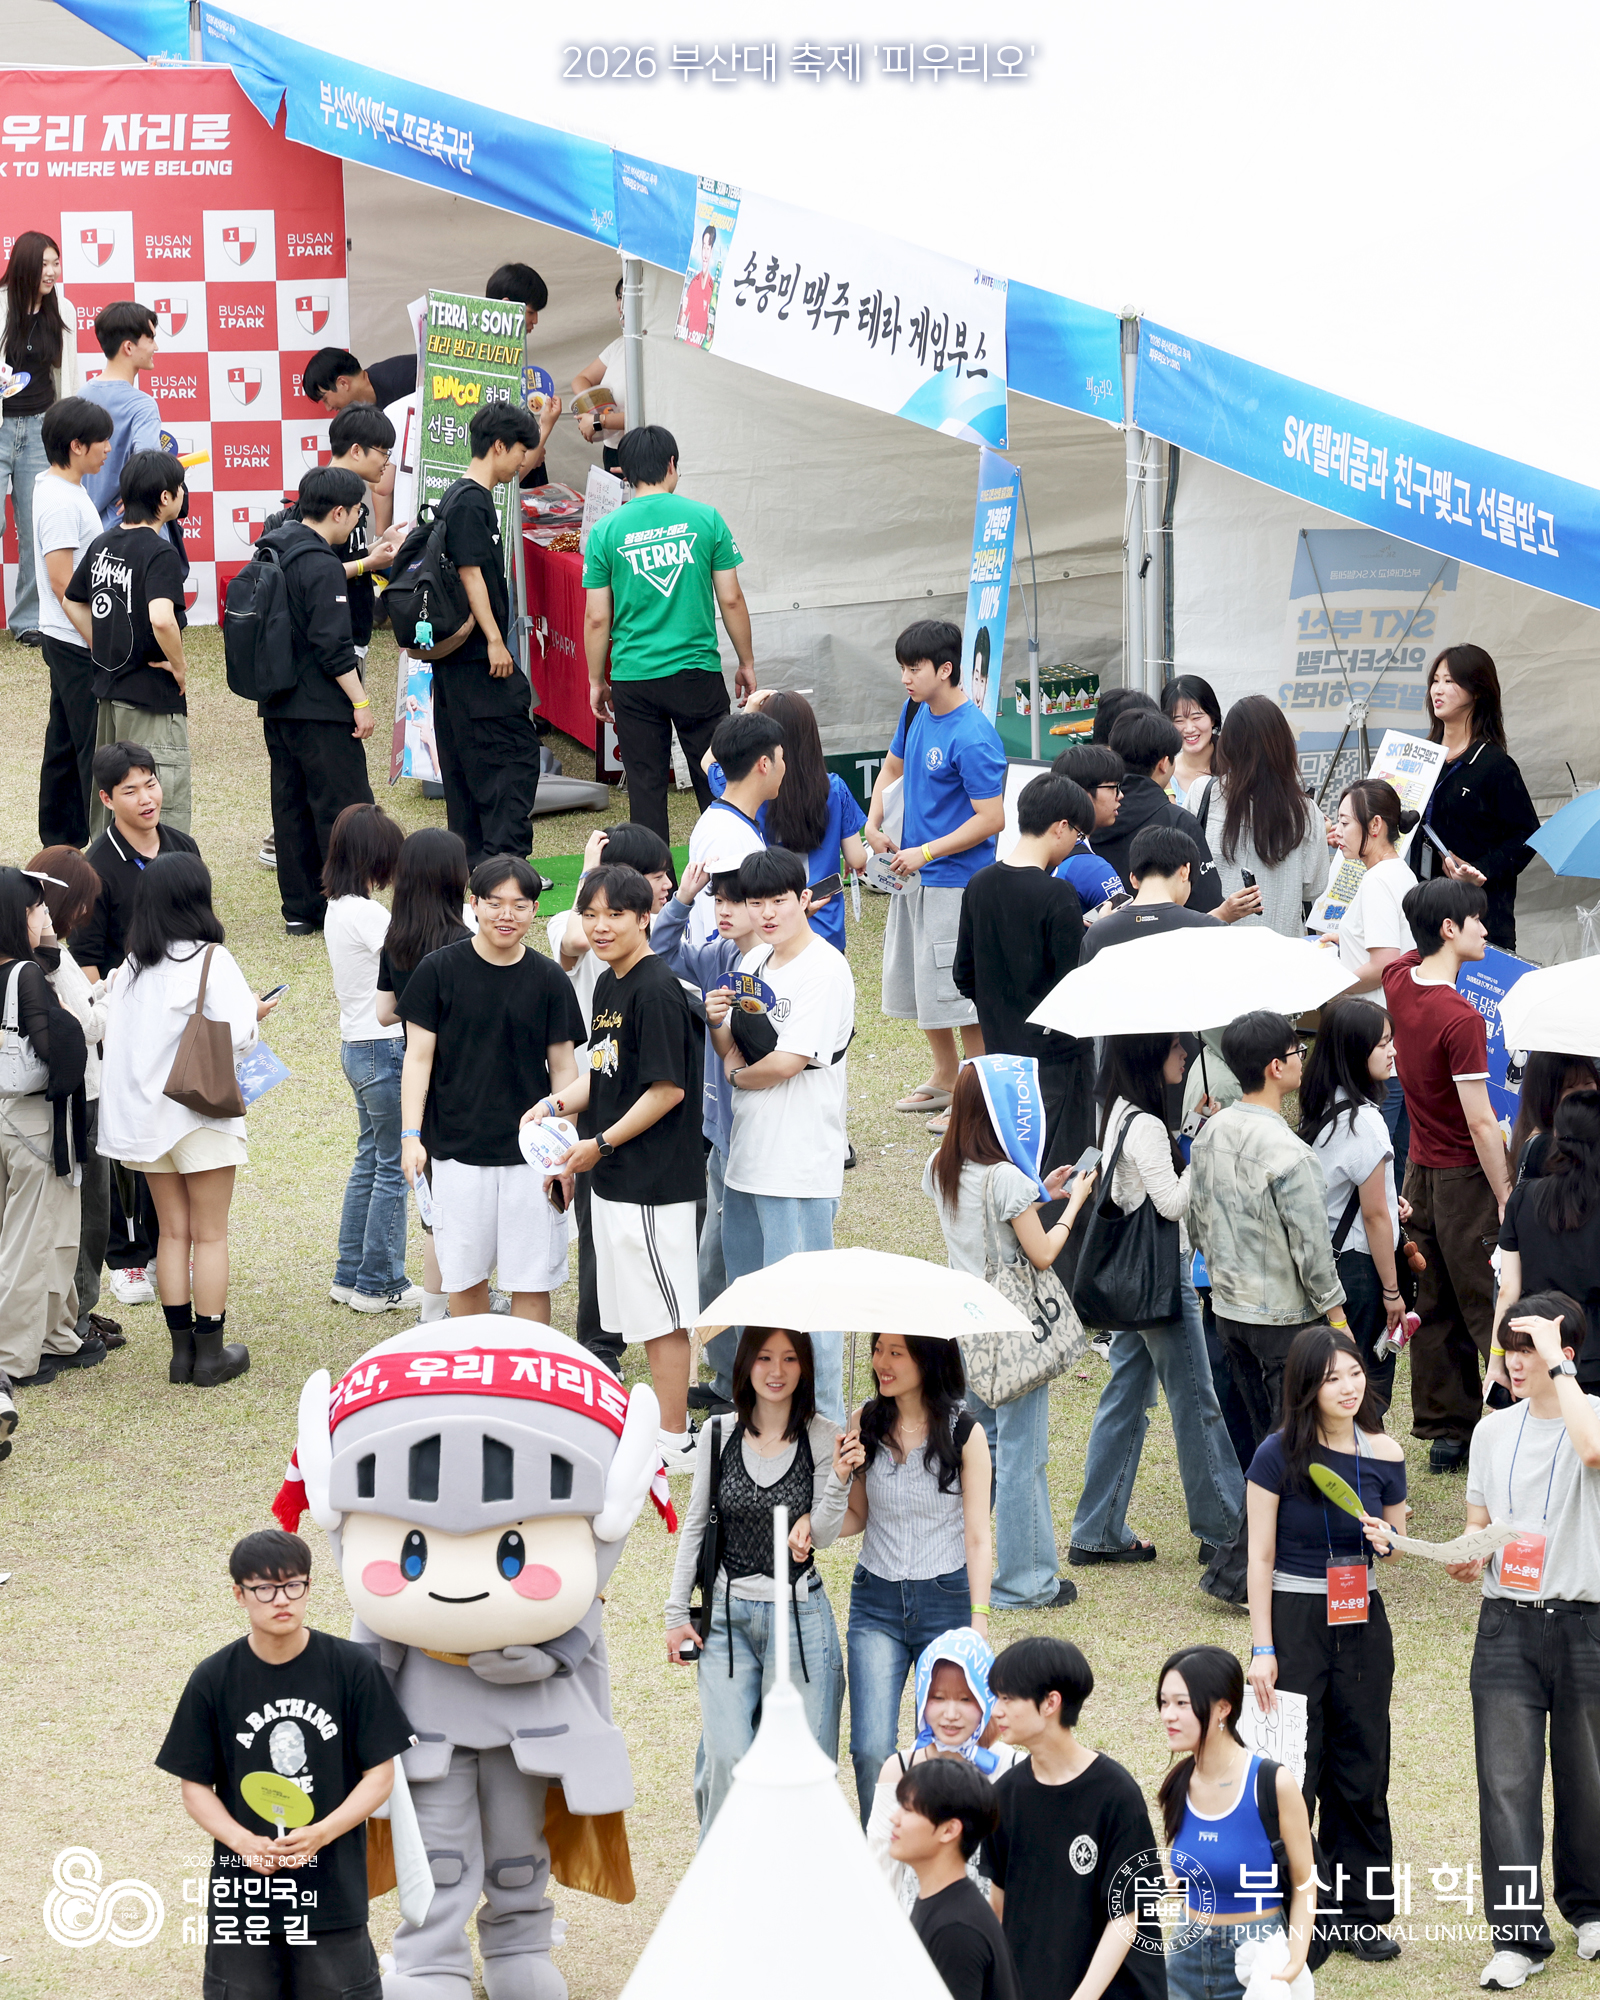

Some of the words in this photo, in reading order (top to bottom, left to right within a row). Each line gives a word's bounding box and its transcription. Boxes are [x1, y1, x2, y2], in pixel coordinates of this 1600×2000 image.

[319, 80, 397, 145] 부산아이파크
[2, 114, 87, 152] 우리
[100, 113, 232, 152] 자리로
[13, 161, 39, 177] TO
[47, 161, 116, 177] WHERE
[120, 161, 150, 177] WE
[154, 159, 233, 176] BELONG
[145, 235, 192, 246] BUSAN
[287, 232, 334, 245] BUSAN
[218, 305, 265, 317] BUSAN
[428, 301, 469, 331] TERRA
[733, 251, 802, 321] 손흥민
[803, 272, 850, 336] 맥주
[858, 289, 902, 356] 테라
[909, 305, 989, 380] 게임부스
[427, 334, 452, 355] 테라
[453, 338, 477, 359] 빙고
[477, 342, 523, 365] EVENT
[151, 375, 198, 387] BUSAN
[432, 375, 481, 407] BINGO!
[224, 444, 270, 456] BUSAN
[1282, 415, 1389, 501] SK텔레콤과
[1393, 453, 1474, 528] 친구맺고
[1476, 487, 1561, 558] 선물받고
[624, 539, 695, 576] TERRA
[977, 585, 1002, 621] 100%
[405, 1355, 495, 1386] 우리
[1503, 1562, 1540, 1579] 부스운영
[1330, 1597, 1365, 1611] 부스운영
[245, 1698, 339, 1742] BATHING
[236, 1731, 256, 1750] A
